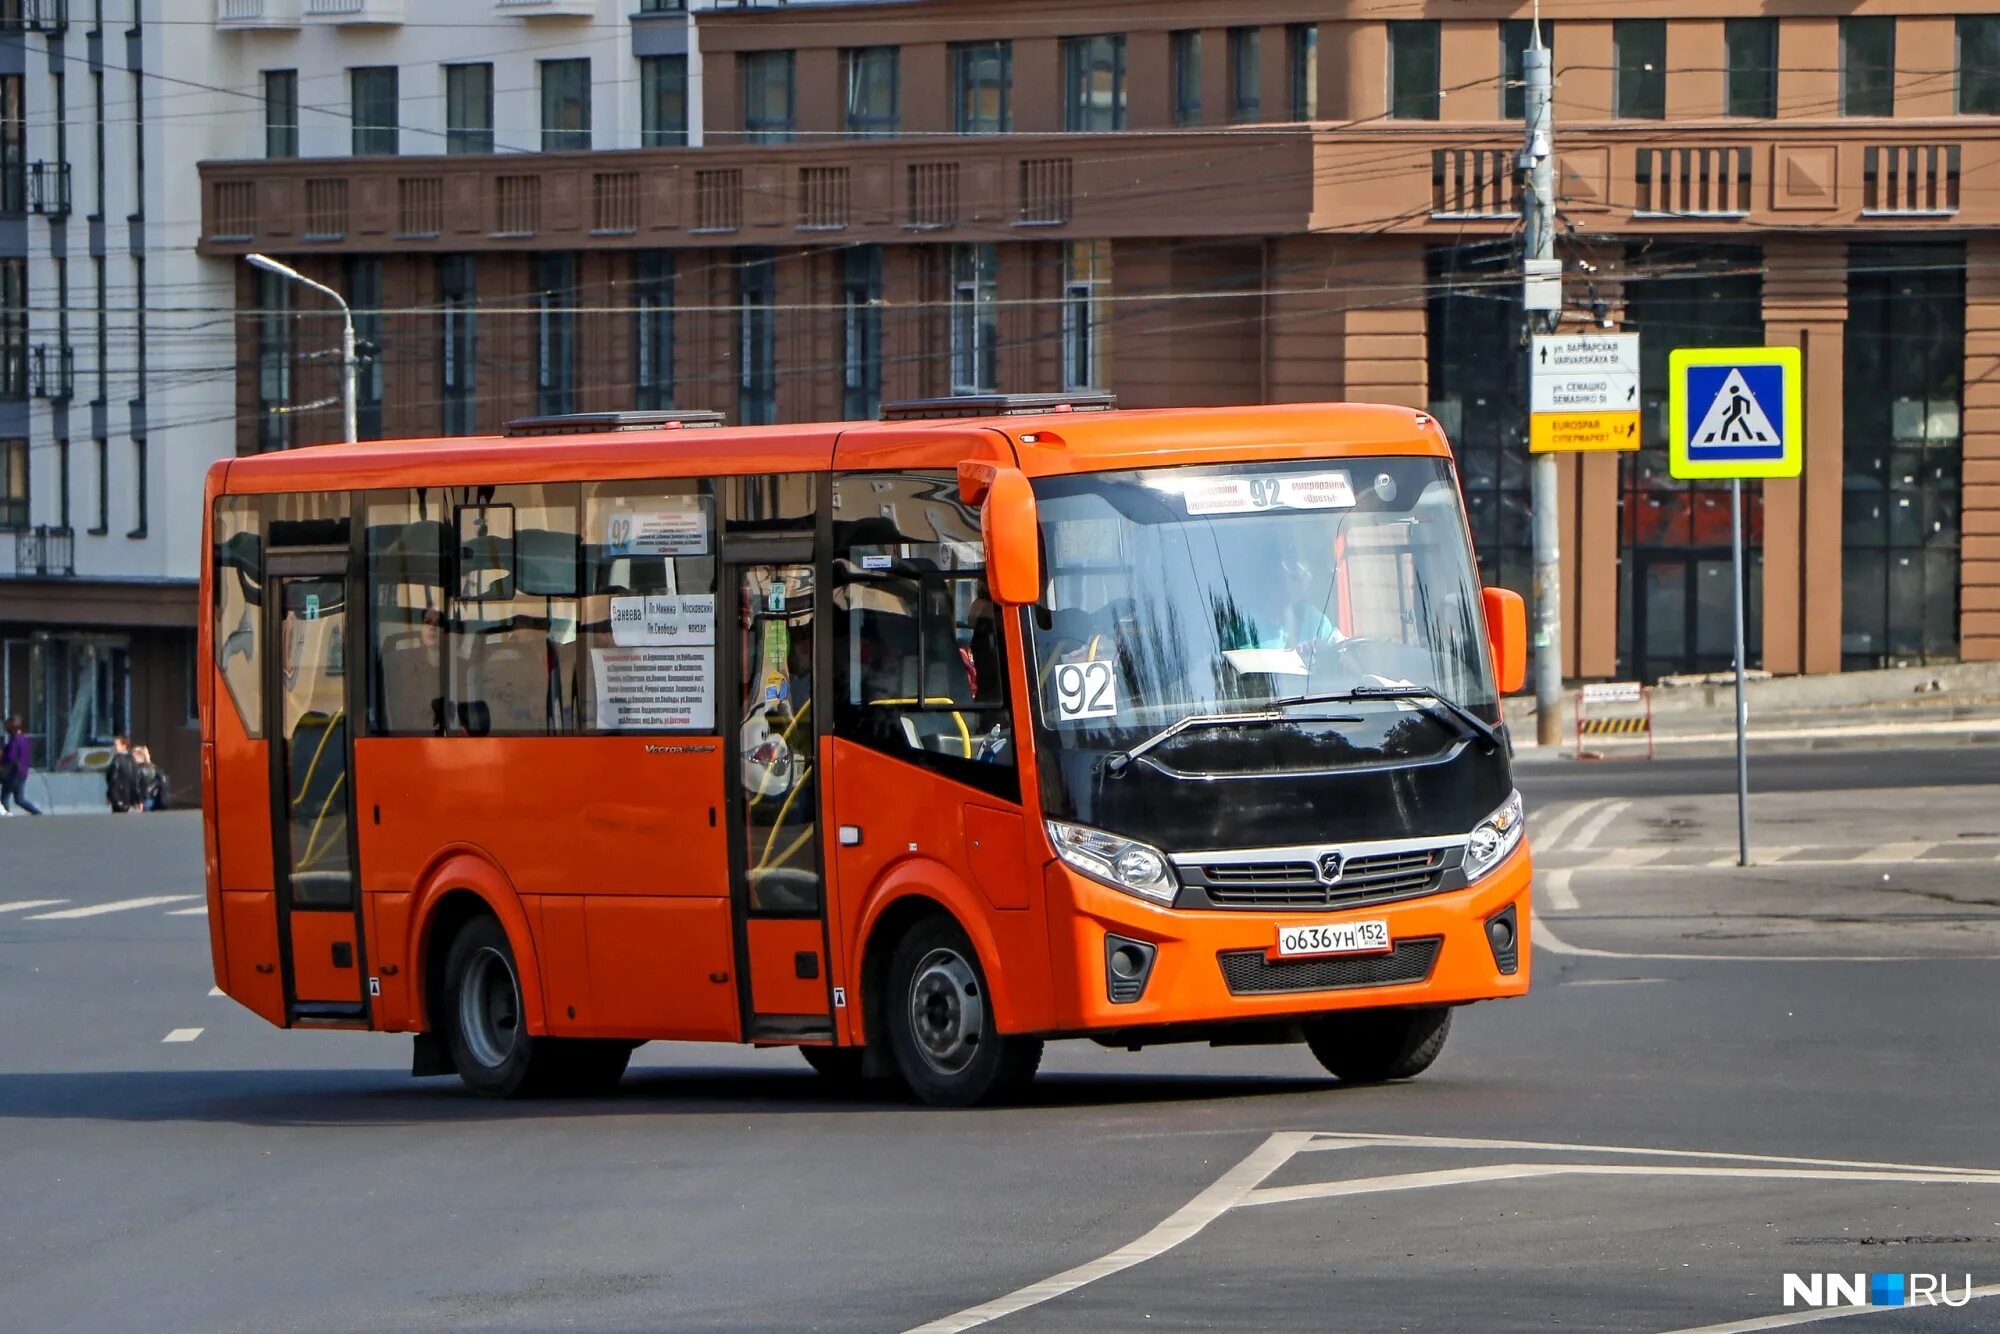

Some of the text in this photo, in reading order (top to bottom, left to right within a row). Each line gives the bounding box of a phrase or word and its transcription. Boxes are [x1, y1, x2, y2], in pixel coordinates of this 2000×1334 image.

[1553, 354, 1608, 365] VARVARSKAYA
[1566, 381, 1608, 392] СЕМАШКО
[1553, 394, 1598, 405] SEMASHKO
[1552, 420, 1601, 431] EUROSPAR
[1249, 478, 1285, 507] 92
[612, 605, 642, 621] Ванеева
[682, 601, 714, 614] Московский
[1058, 663, 1114, 714] 92
[1357, 923, 1384, 940] 152
